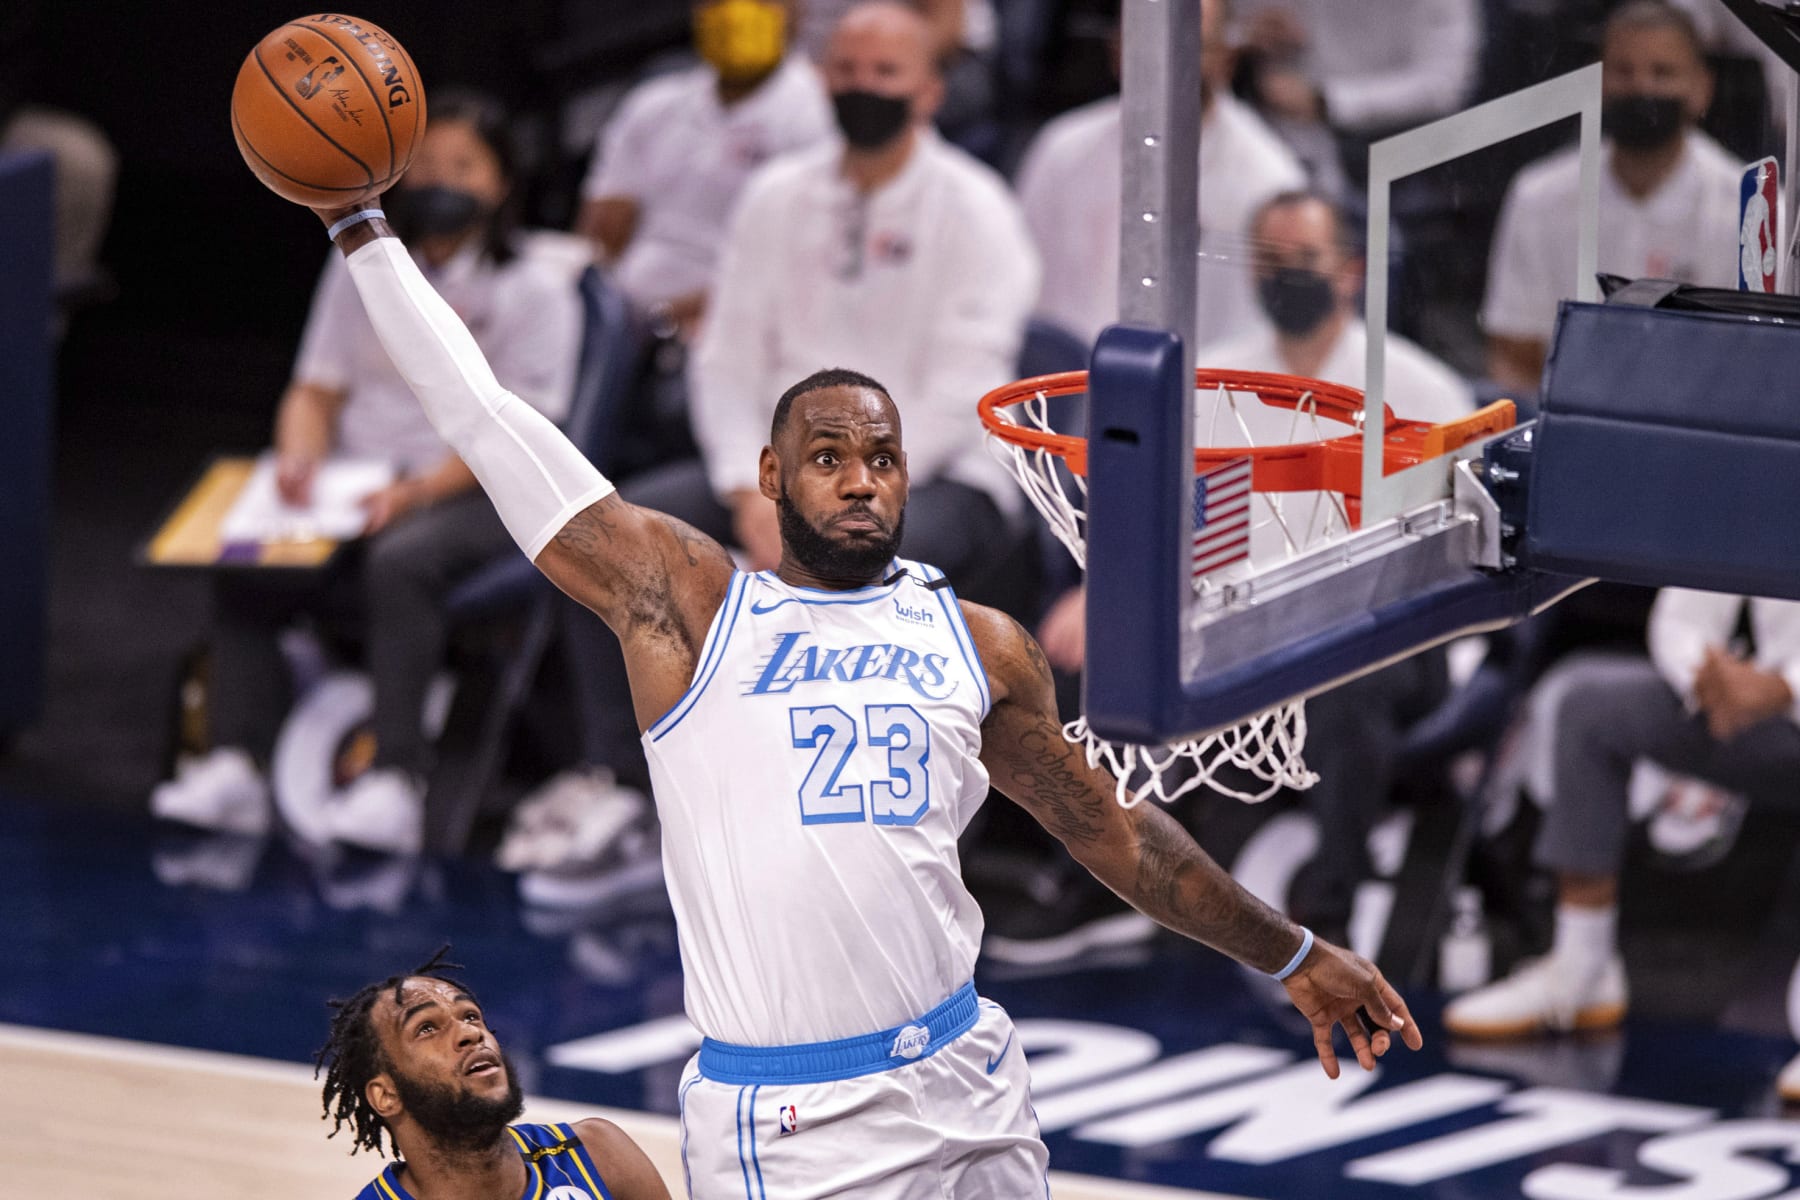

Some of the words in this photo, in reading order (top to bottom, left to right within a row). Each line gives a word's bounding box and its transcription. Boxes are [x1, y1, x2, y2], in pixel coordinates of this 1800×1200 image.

[312, 14, 411, 109] SPALDING
[893, 597, 933, 622] wish
[740, 631, 959, 700] LAKERS
[789, 704, 930, 826] 23
